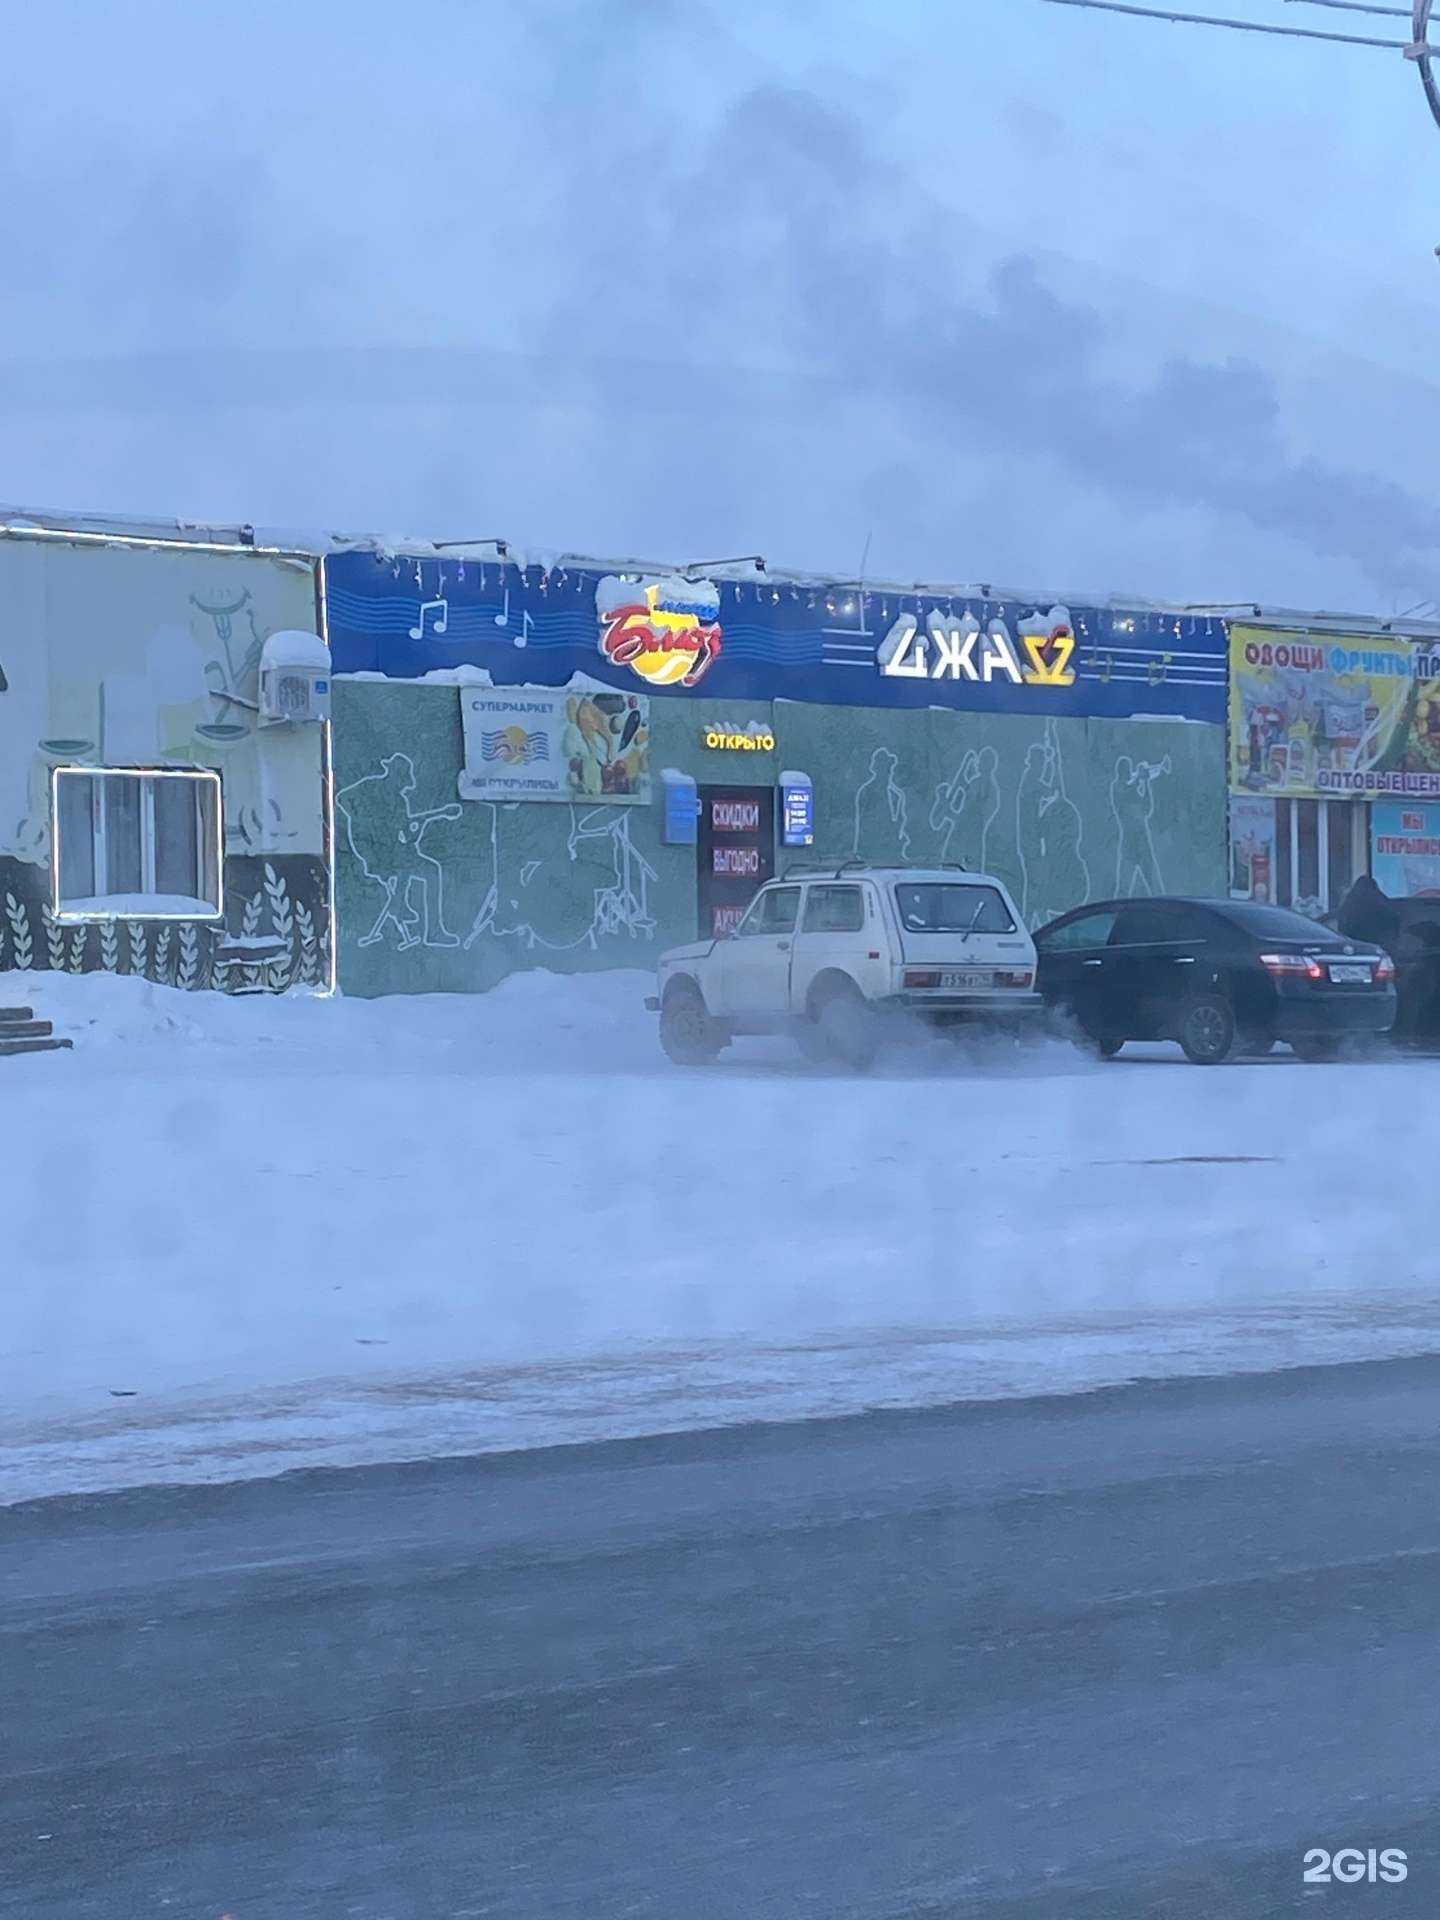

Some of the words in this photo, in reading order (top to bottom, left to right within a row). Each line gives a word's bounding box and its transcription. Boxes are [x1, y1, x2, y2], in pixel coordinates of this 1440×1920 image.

[1245, 642, 1323, 672] ОВОЩИ
[1330, 646, 1413, 676] ФРУКТЫ
[472, 700, 554, 714] СУПЕРМАРКЕТ
[706, 732, 775, 750] ОТКРЫТО
[1318, 771, 1401, 790] ОПТОВЫЕ
[712, 803, 759, 829] СКИДКИ
[713, 850, 759, 875] ВЫГОДНО
